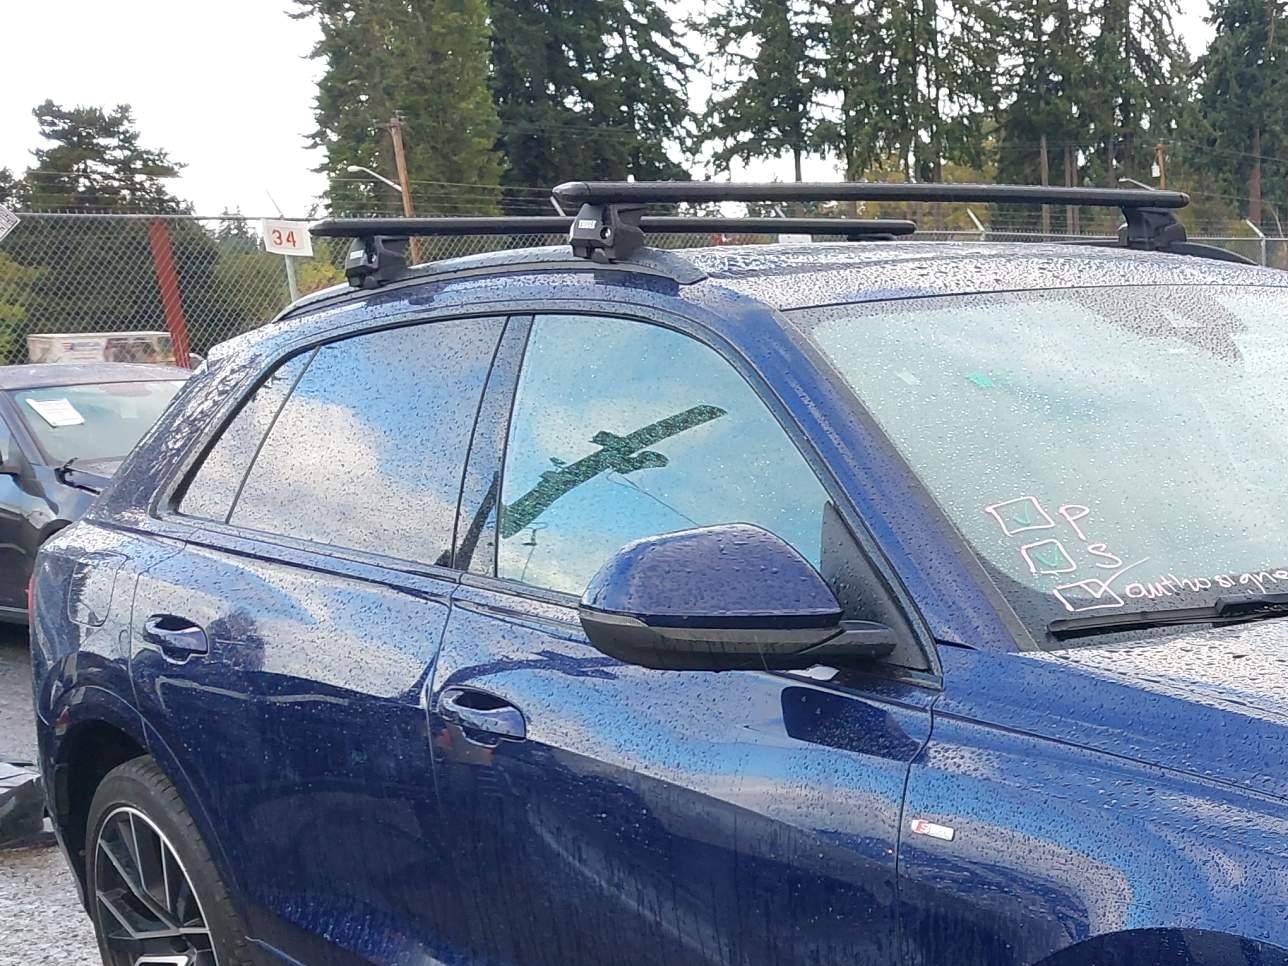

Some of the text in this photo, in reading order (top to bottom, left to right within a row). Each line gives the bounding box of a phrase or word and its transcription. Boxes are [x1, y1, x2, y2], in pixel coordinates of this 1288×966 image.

[272, 229, 296, 247] 34
[1059, 504, 1090, 541] P
[1088, 544, 1122, 568] S
